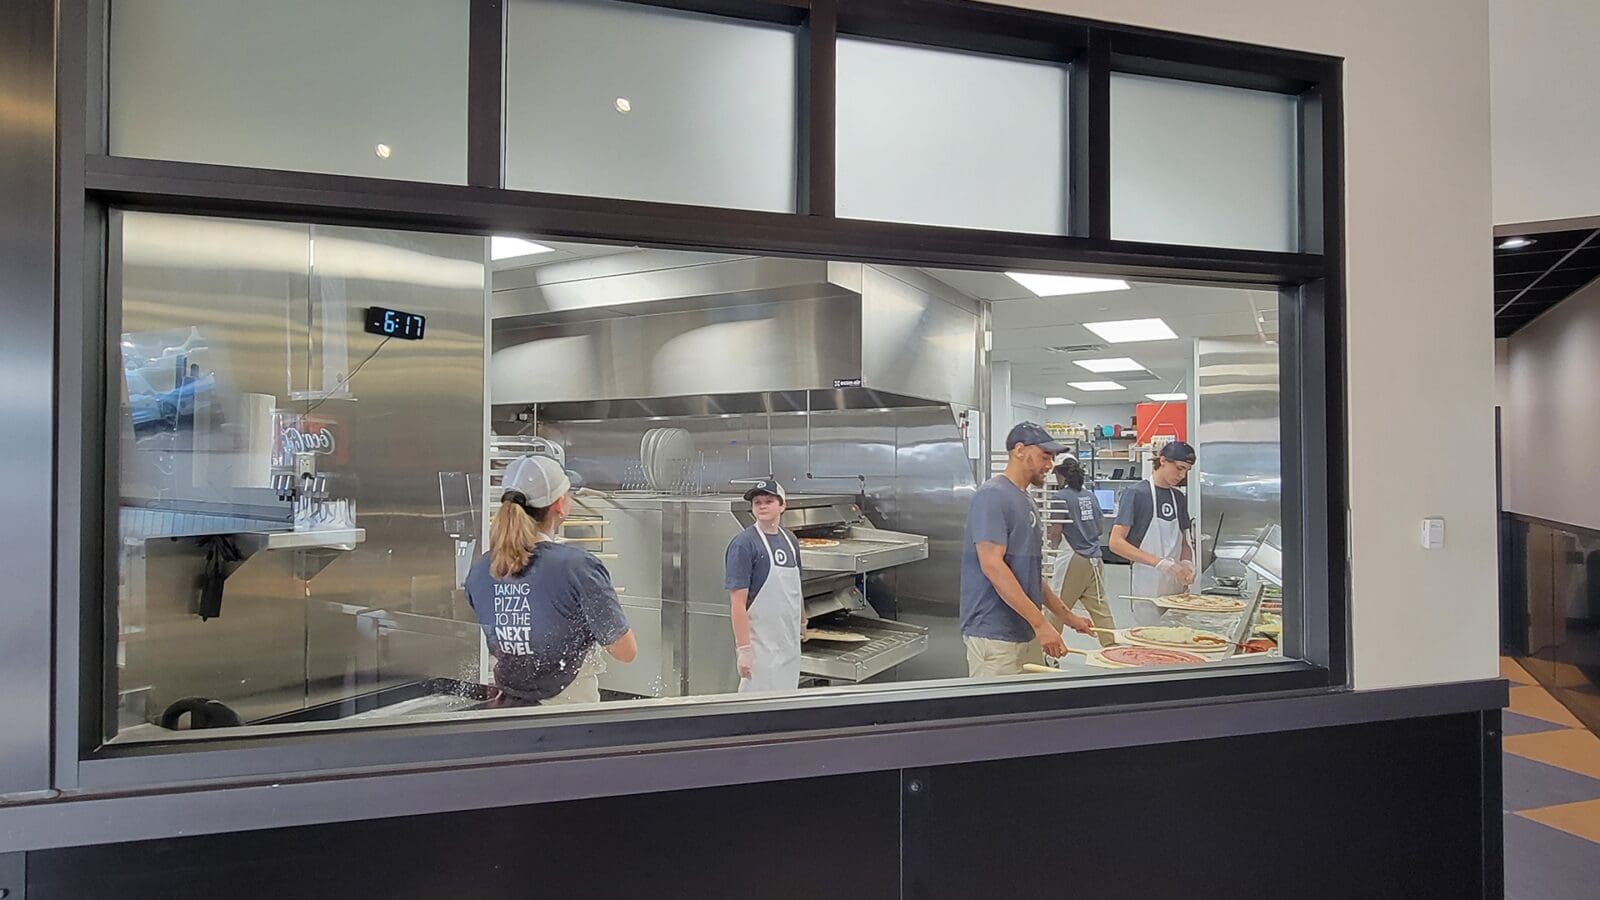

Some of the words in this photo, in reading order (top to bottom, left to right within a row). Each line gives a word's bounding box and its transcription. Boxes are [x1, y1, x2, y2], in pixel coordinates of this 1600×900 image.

[494, 583, 530, 596] TAKING
[494, 597, 531, 611] PIZZA
[494, 613, 509, 625] TO
[512, 613, 531, 625] THE
[495, 627, 531, 641] NEXT
[498, 641, 534, 656] LEVEL
